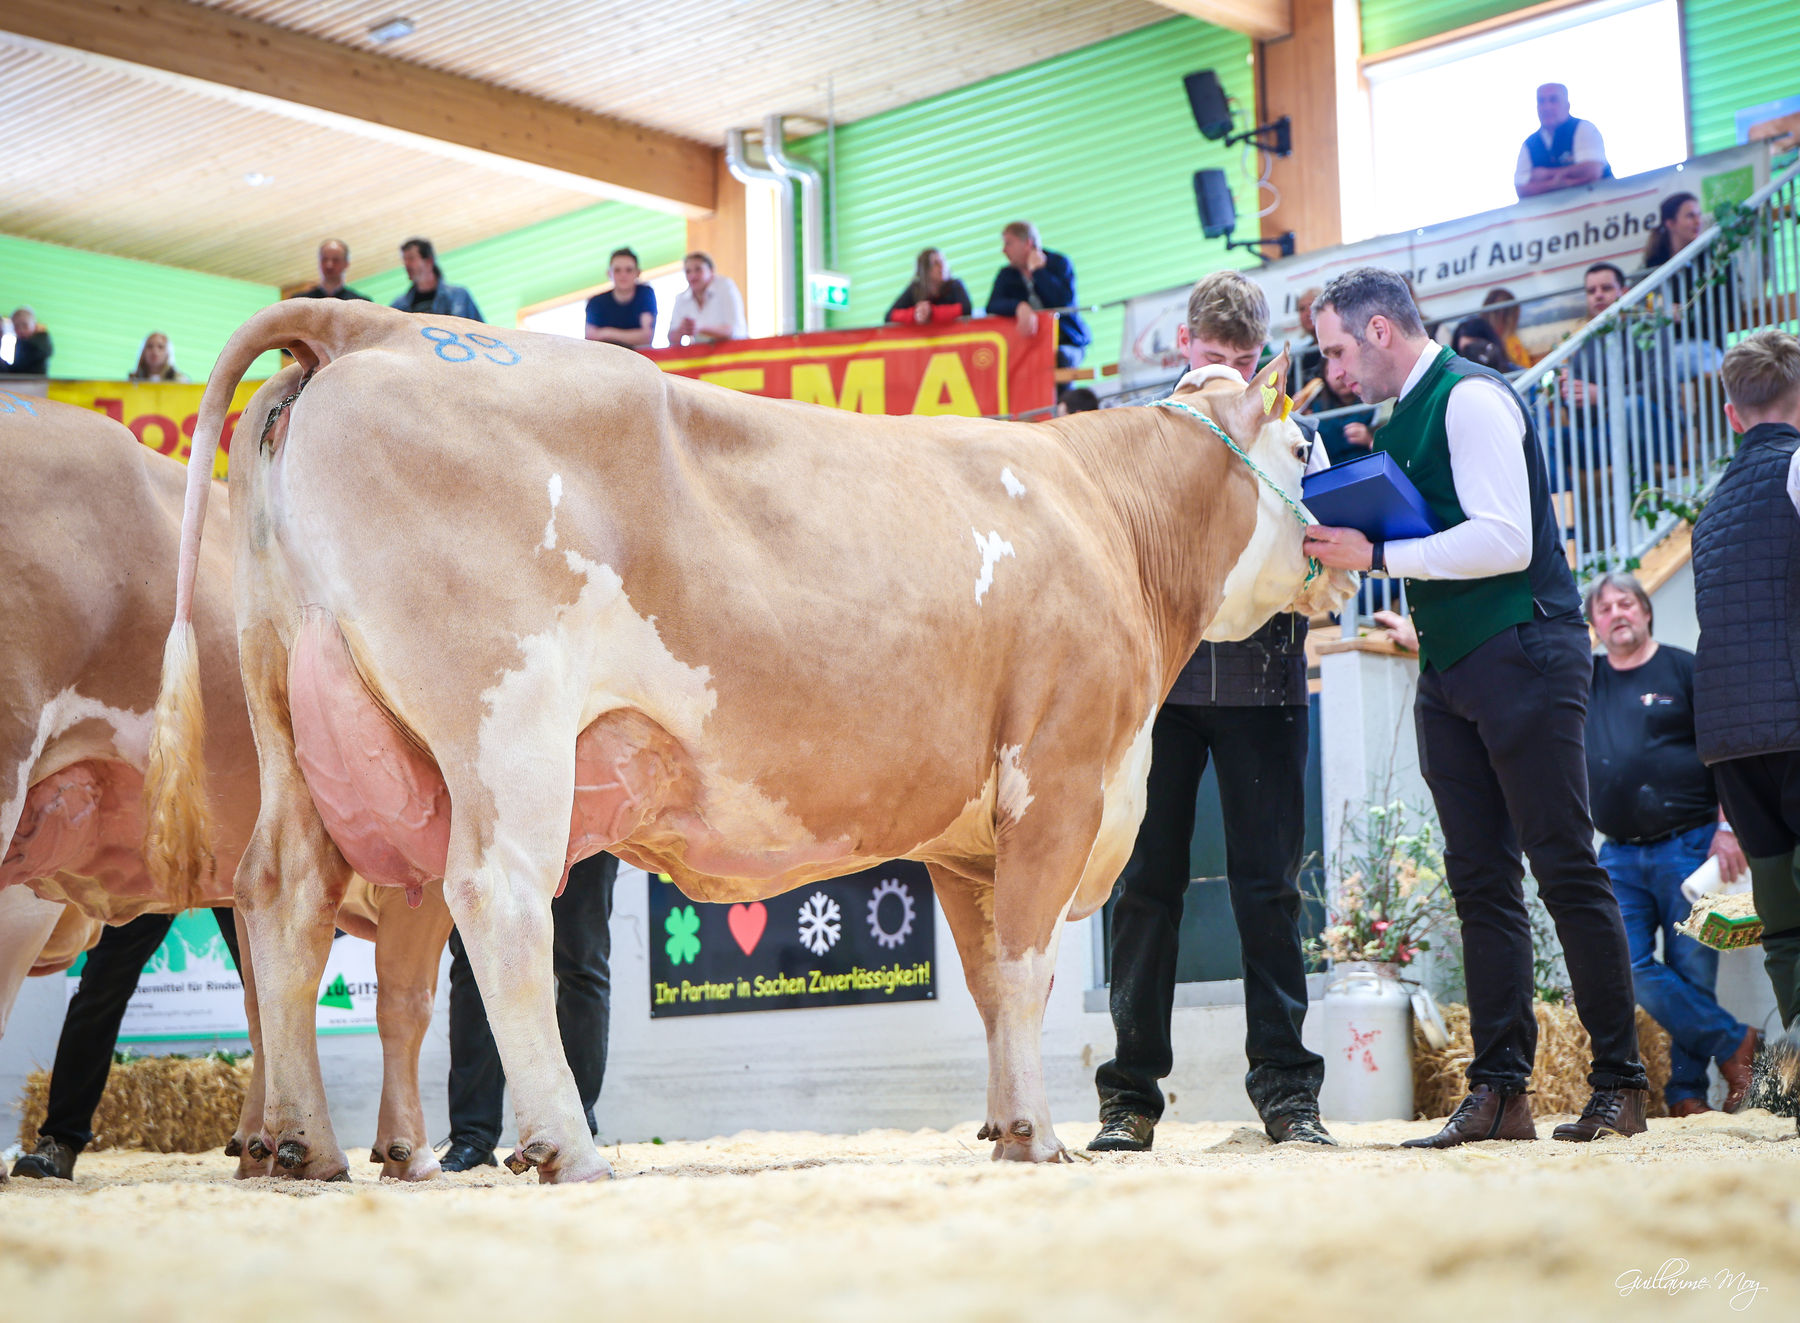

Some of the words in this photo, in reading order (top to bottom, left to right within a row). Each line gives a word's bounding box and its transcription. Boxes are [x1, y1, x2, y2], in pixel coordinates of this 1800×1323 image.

[1437, 246, 1478, 280] auf
[1489, 211, 1658, 266] Augenhöhe
[420, 326, 522, 366] 89
[655, 981, 679, 1004] Ihr
[681, 980, 734, 1002] Partner
[737, 976, 751, 998] in
[753, 972, 806, 998] Sachen
[808, 960, 931, 995] Zuverlässigkeit!
